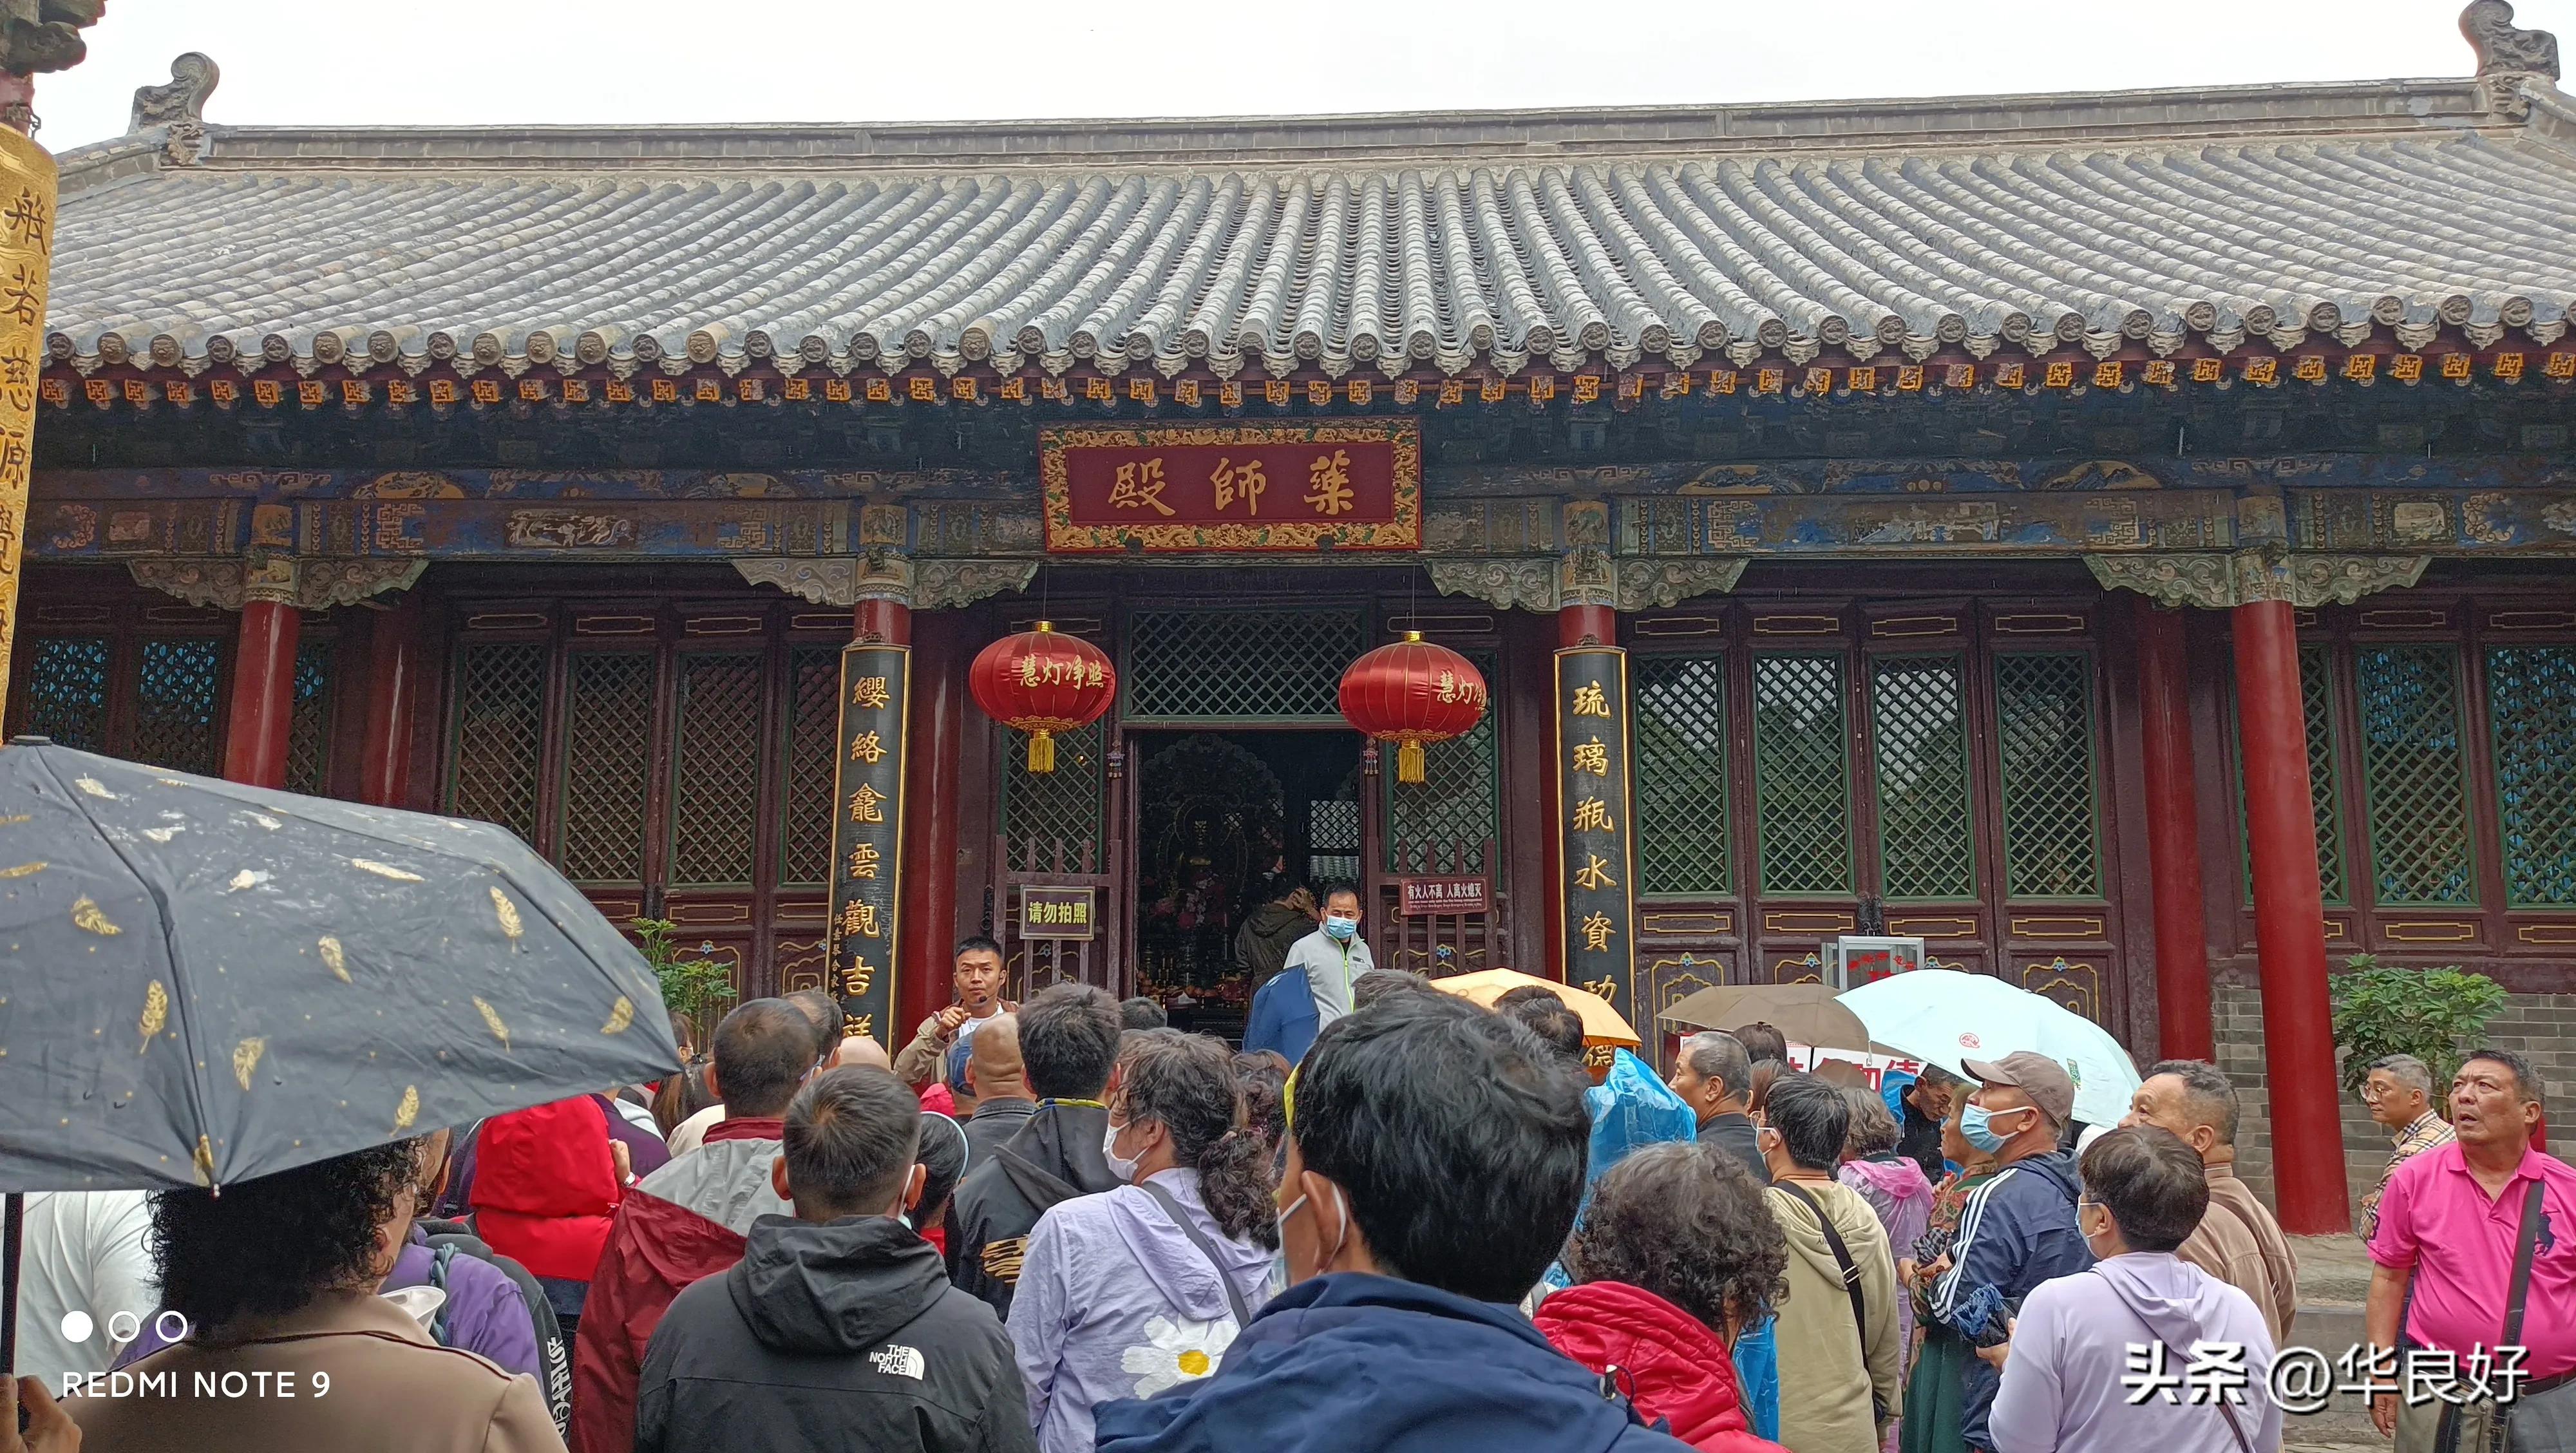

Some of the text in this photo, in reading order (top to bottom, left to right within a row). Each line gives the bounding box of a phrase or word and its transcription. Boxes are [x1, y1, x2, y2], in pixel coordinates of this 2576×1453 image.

[1020, 654, 1104, 690] 慧灯净照
[1028, 901, 1087, 924] 请勿拍照
[887, 1344, 909, 1356] THE
[869, 1351, 907, 1366] NORTH
[877, 1363, 906, 1375] FACE
